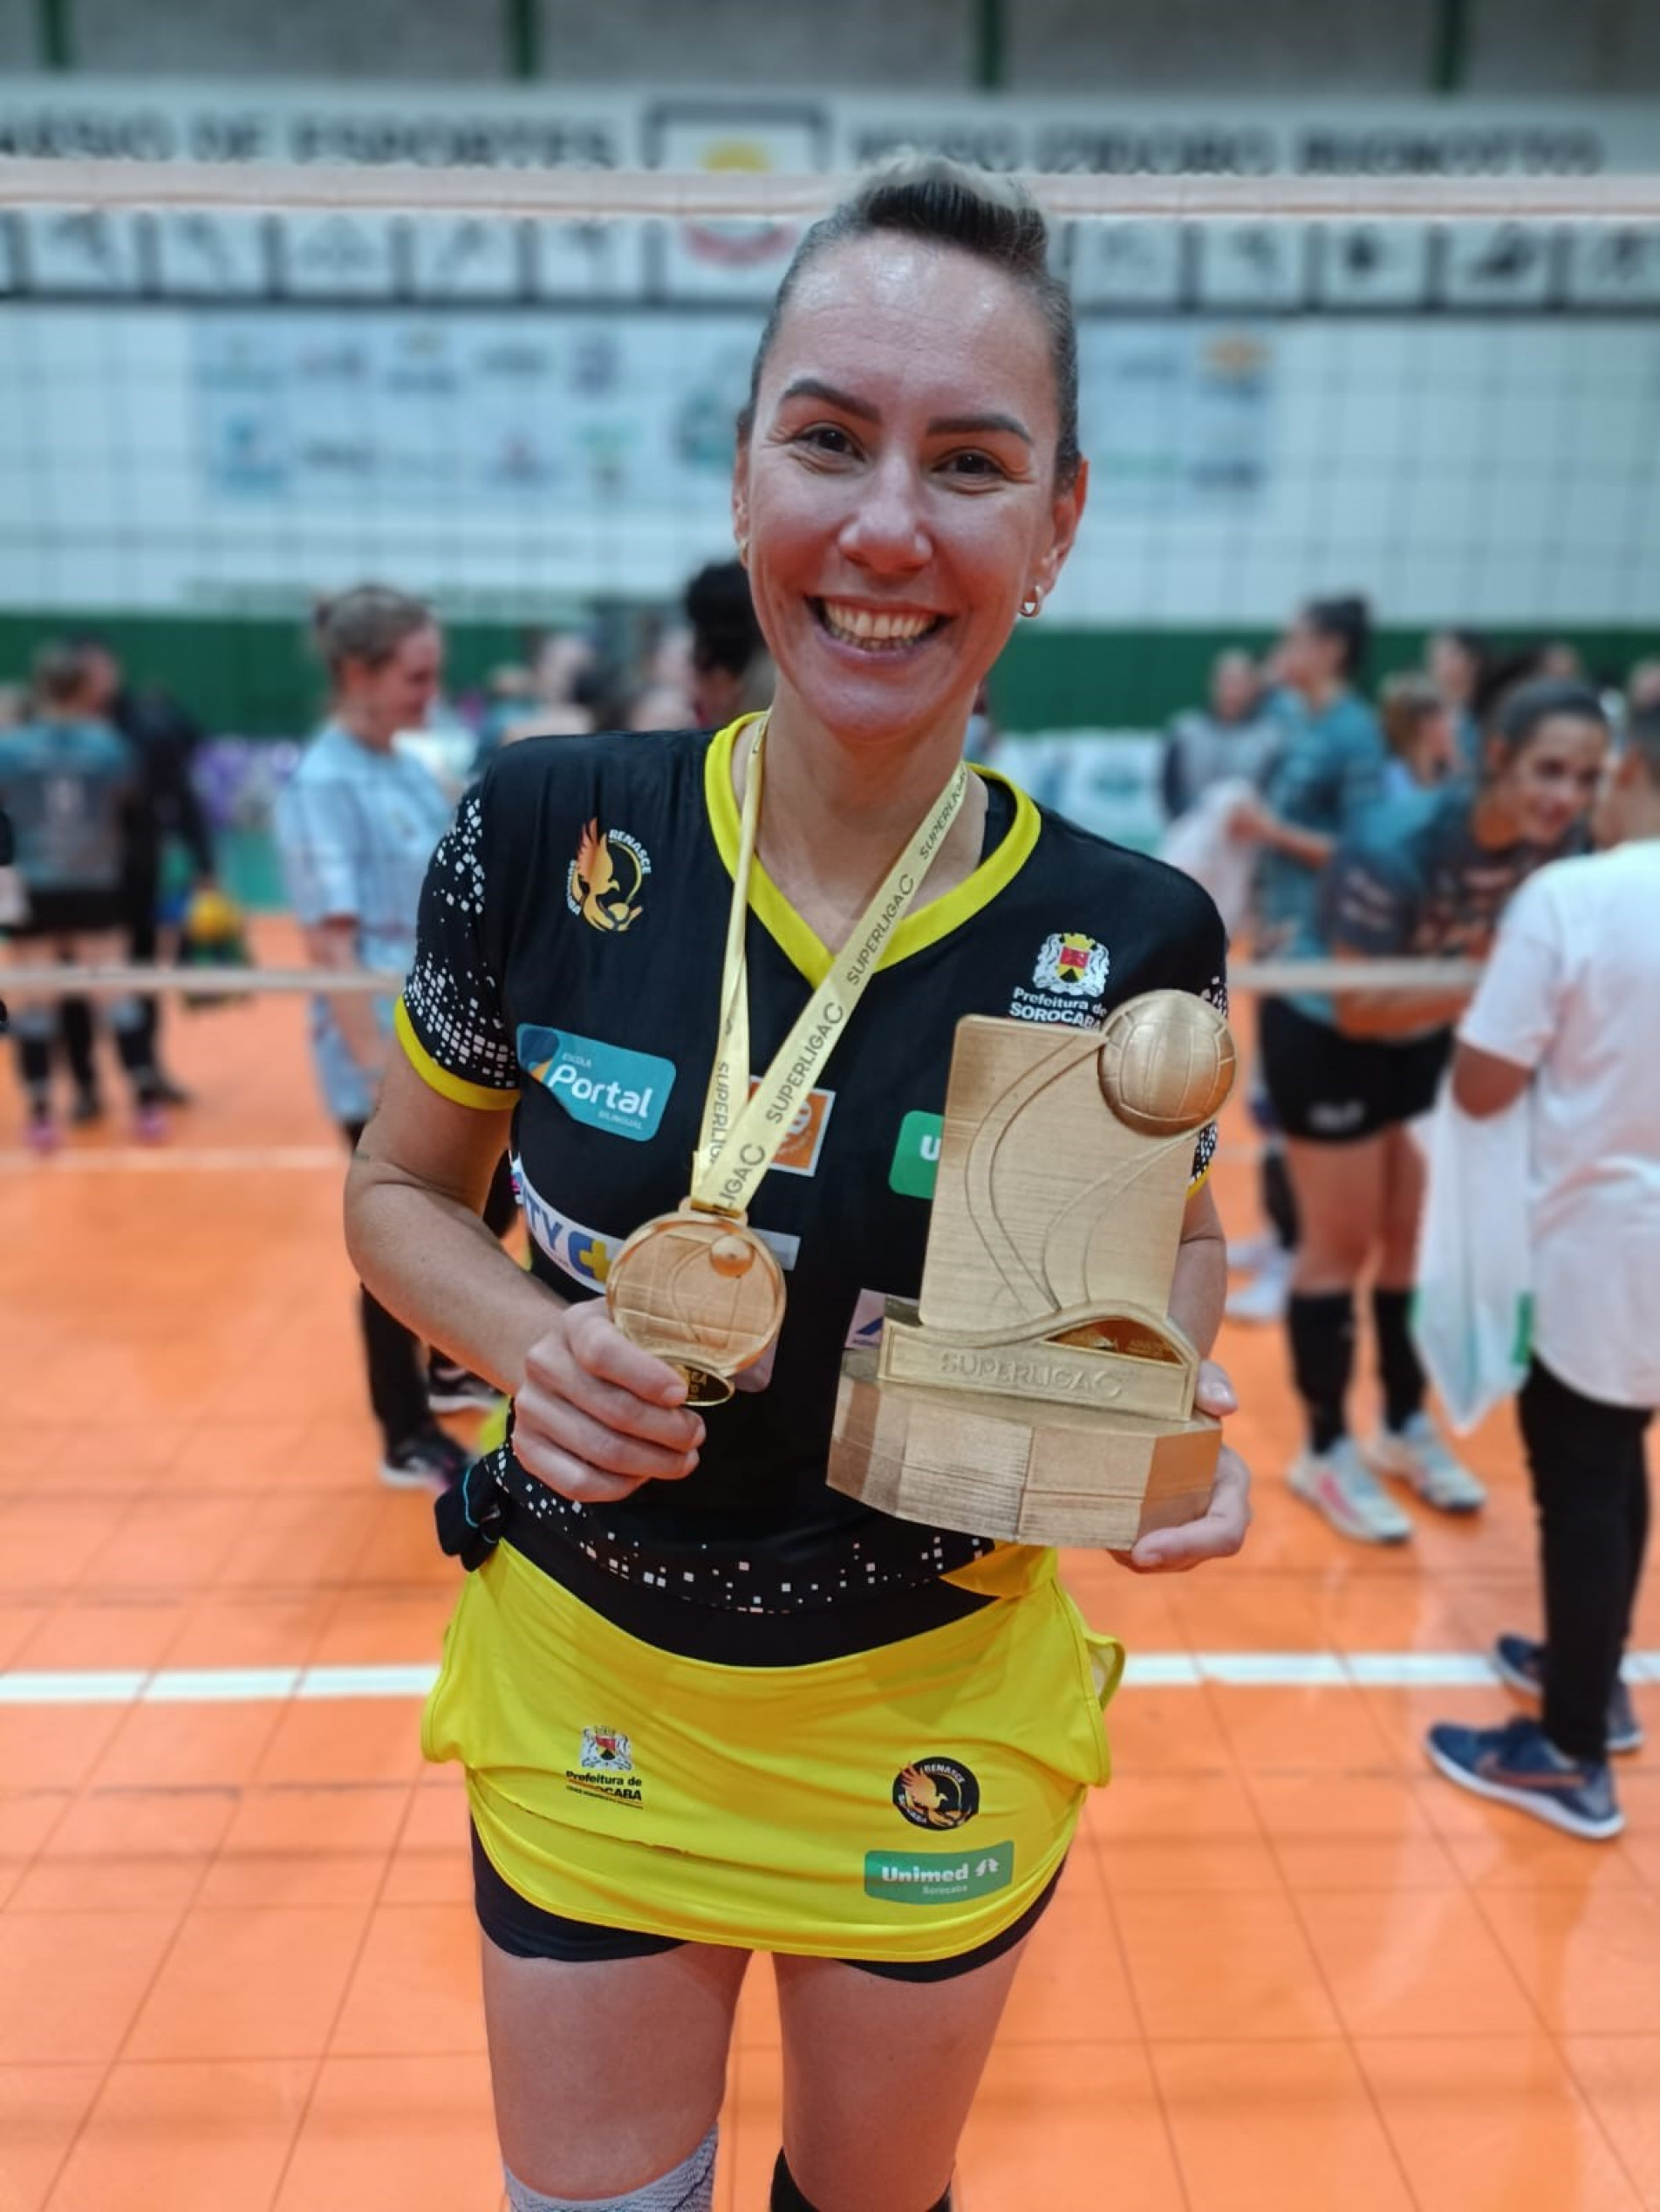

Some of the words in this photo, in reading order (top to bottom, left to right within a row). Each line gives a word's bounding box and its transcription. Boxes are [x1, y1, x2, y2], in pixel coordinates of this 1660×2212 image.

[609, 829, 652, 875] RENASCE
[1014, 987, 1089, 1011] Prefeitura
[765, 1001, 844, 1123] SUPERLIGAC
[548, 1063, 653, 1118] Portal
[565, 1770, 625, 1786] Prefeitura
[627, 1776, 642, 1787] de
[881, 1863, 969, 1882] Unimed
